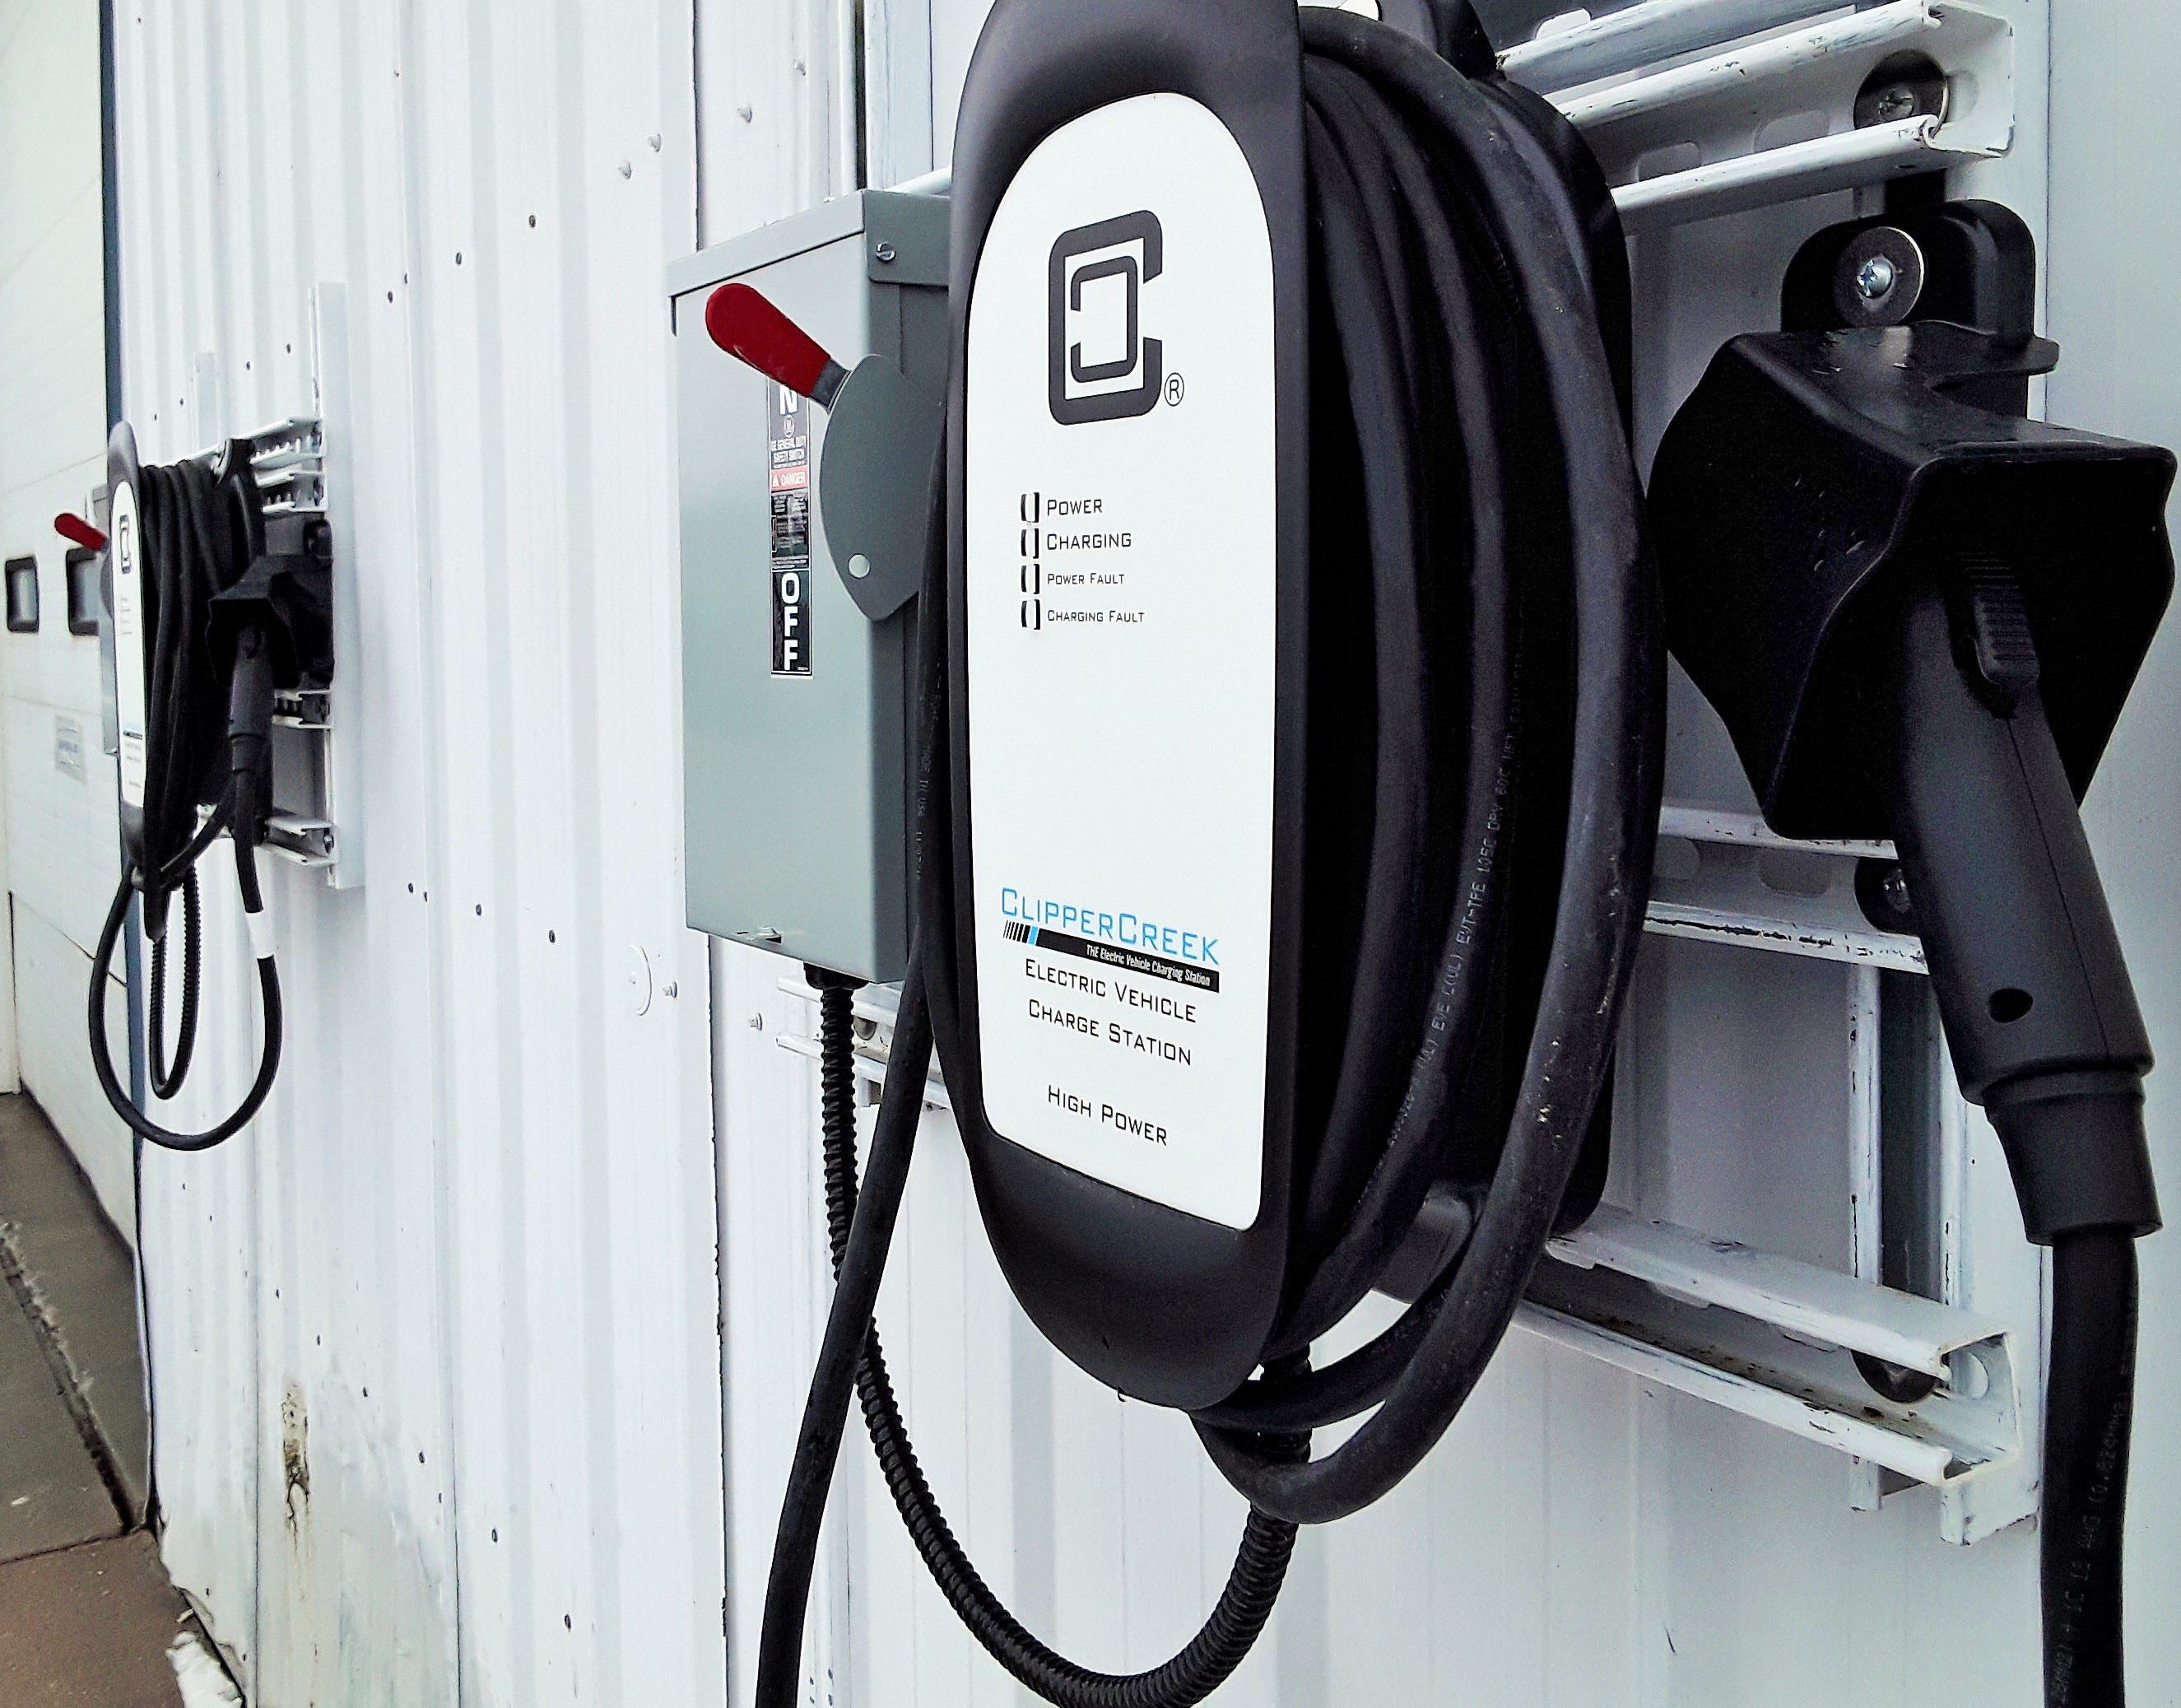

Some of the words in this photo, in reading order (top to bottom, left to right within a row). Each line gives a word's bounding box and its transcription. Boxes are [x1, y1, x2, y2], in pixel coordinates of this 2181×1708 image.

[1047, 499, 1103, 517] POWER
[1046, 533, 1132, 551] CHARGING
[1047, 573, 1085, 585] POWER
[1090, 572, 1125, 585] FAULT
[781, 572, 800, 672] OFF
[1047, 609, 1104, 622] CHARGING
[1109, 610, 1145, 623] FAULT
[1002, 887, 1220, 966] CLIPPERCREEK
[1025, 957, 1106, 998] ELECTRIC
[1114, 982, 1197, 1024] VEHICLE
[1086, 944, 1100, 958] THE
[1100, 947, 1125, 966] Electric
[1126, 952, 1151, 973] Vehicle
[1151, 961, 1184, 982] Charging
[1184, 968, 1211, 987] Station
[1029, 998, 1100, 1037] CHARGE
[1109, 1023, 1192, 1066] STATION
[1048, 1084, 1091, 1118] HIGH
[1101, 1104, 1168, 1147] POWER
